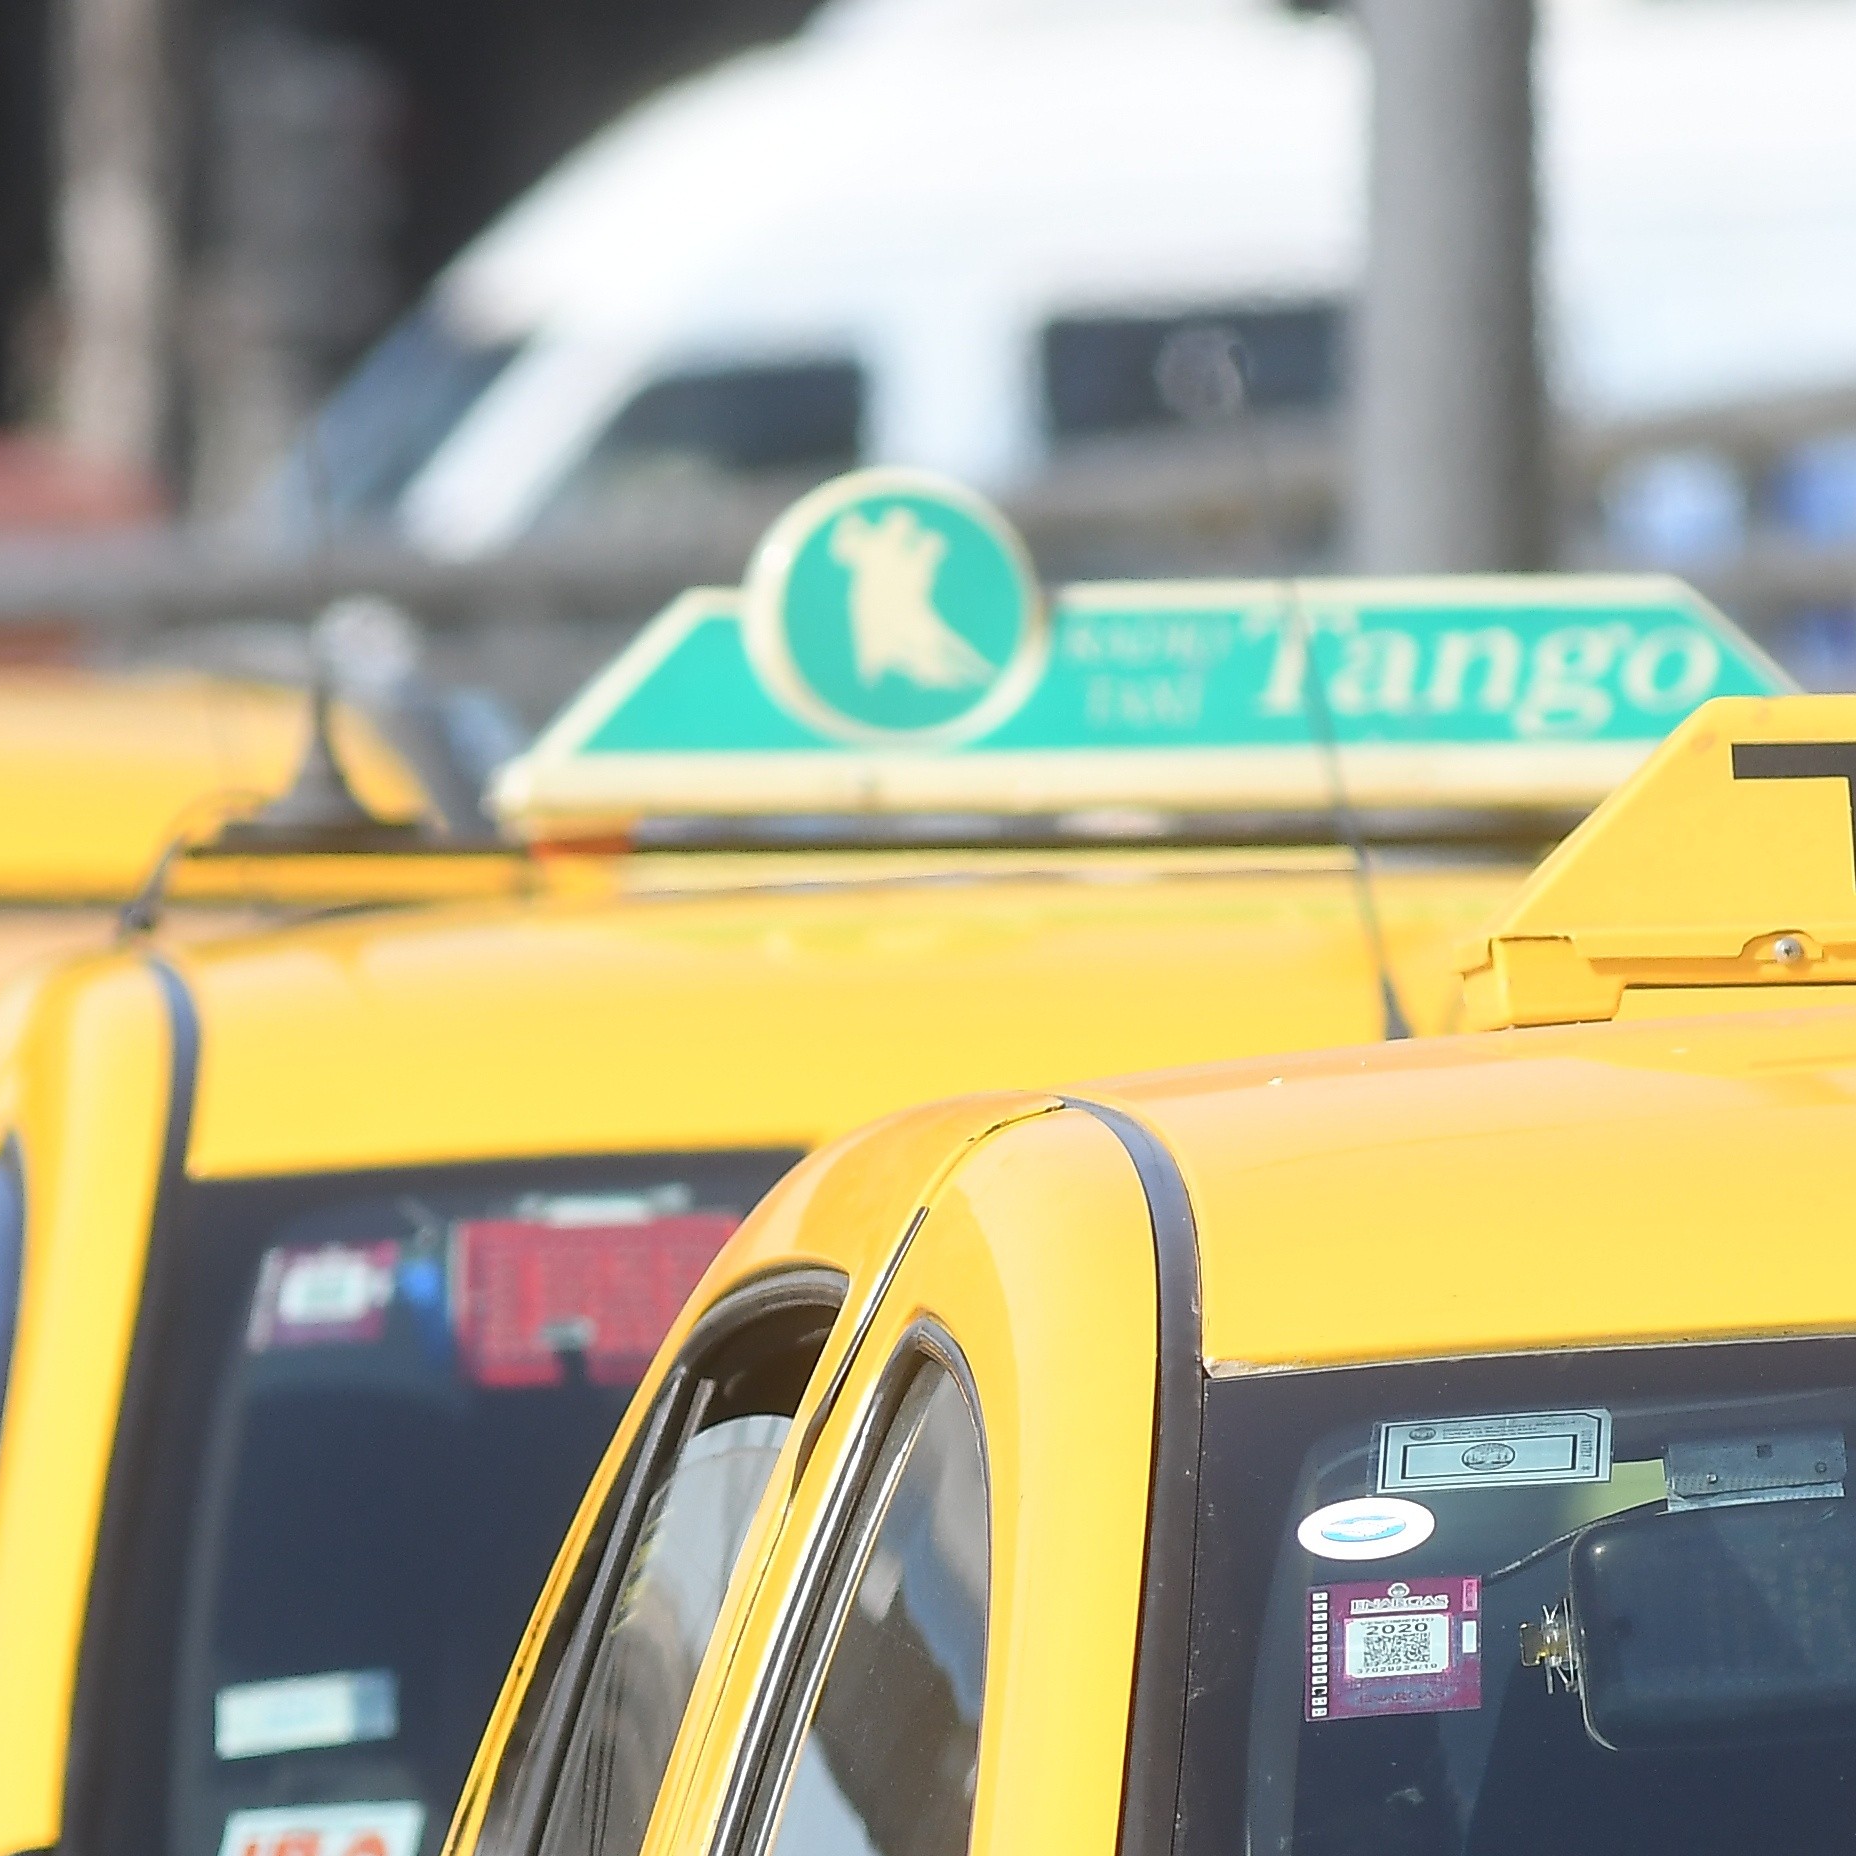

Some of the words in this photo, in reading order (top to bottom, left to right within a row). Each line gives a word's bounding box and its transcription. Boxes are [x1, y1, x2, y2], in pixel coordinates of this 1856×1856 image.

[1240, 603, 1721, 741] Tango
[1352, 1595, 1449, 1614] ENARGAS
[1366, 1623, 1429, 1636] 2020
